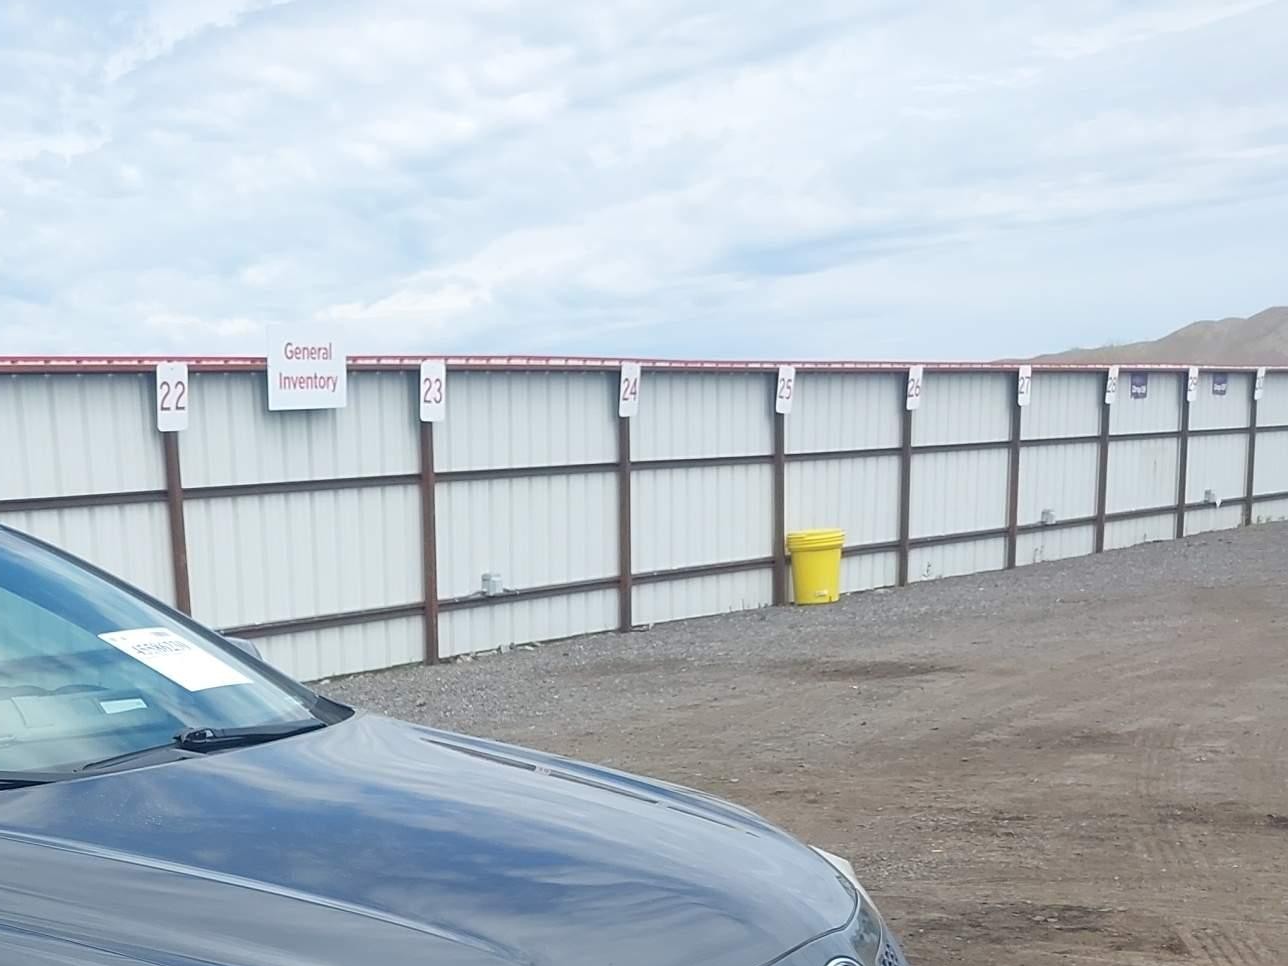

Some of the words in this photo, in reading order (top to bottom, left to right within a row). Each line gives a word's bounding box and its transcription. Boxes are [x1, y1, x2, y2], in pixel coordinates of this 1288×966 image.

[283, 342, 333, 361] General
[278, 371, 339, 393] Inventory
[423, 377, 443, 404] 23
[623, 377, 638, 401] 24
[778, 378, 793, 400] 25
[907, 378, 921, 398] 26
[1019, 375, 1031, 395] 27
[1106, 376, 1117, 393] 28
[160, 381, 186, 411] 22
